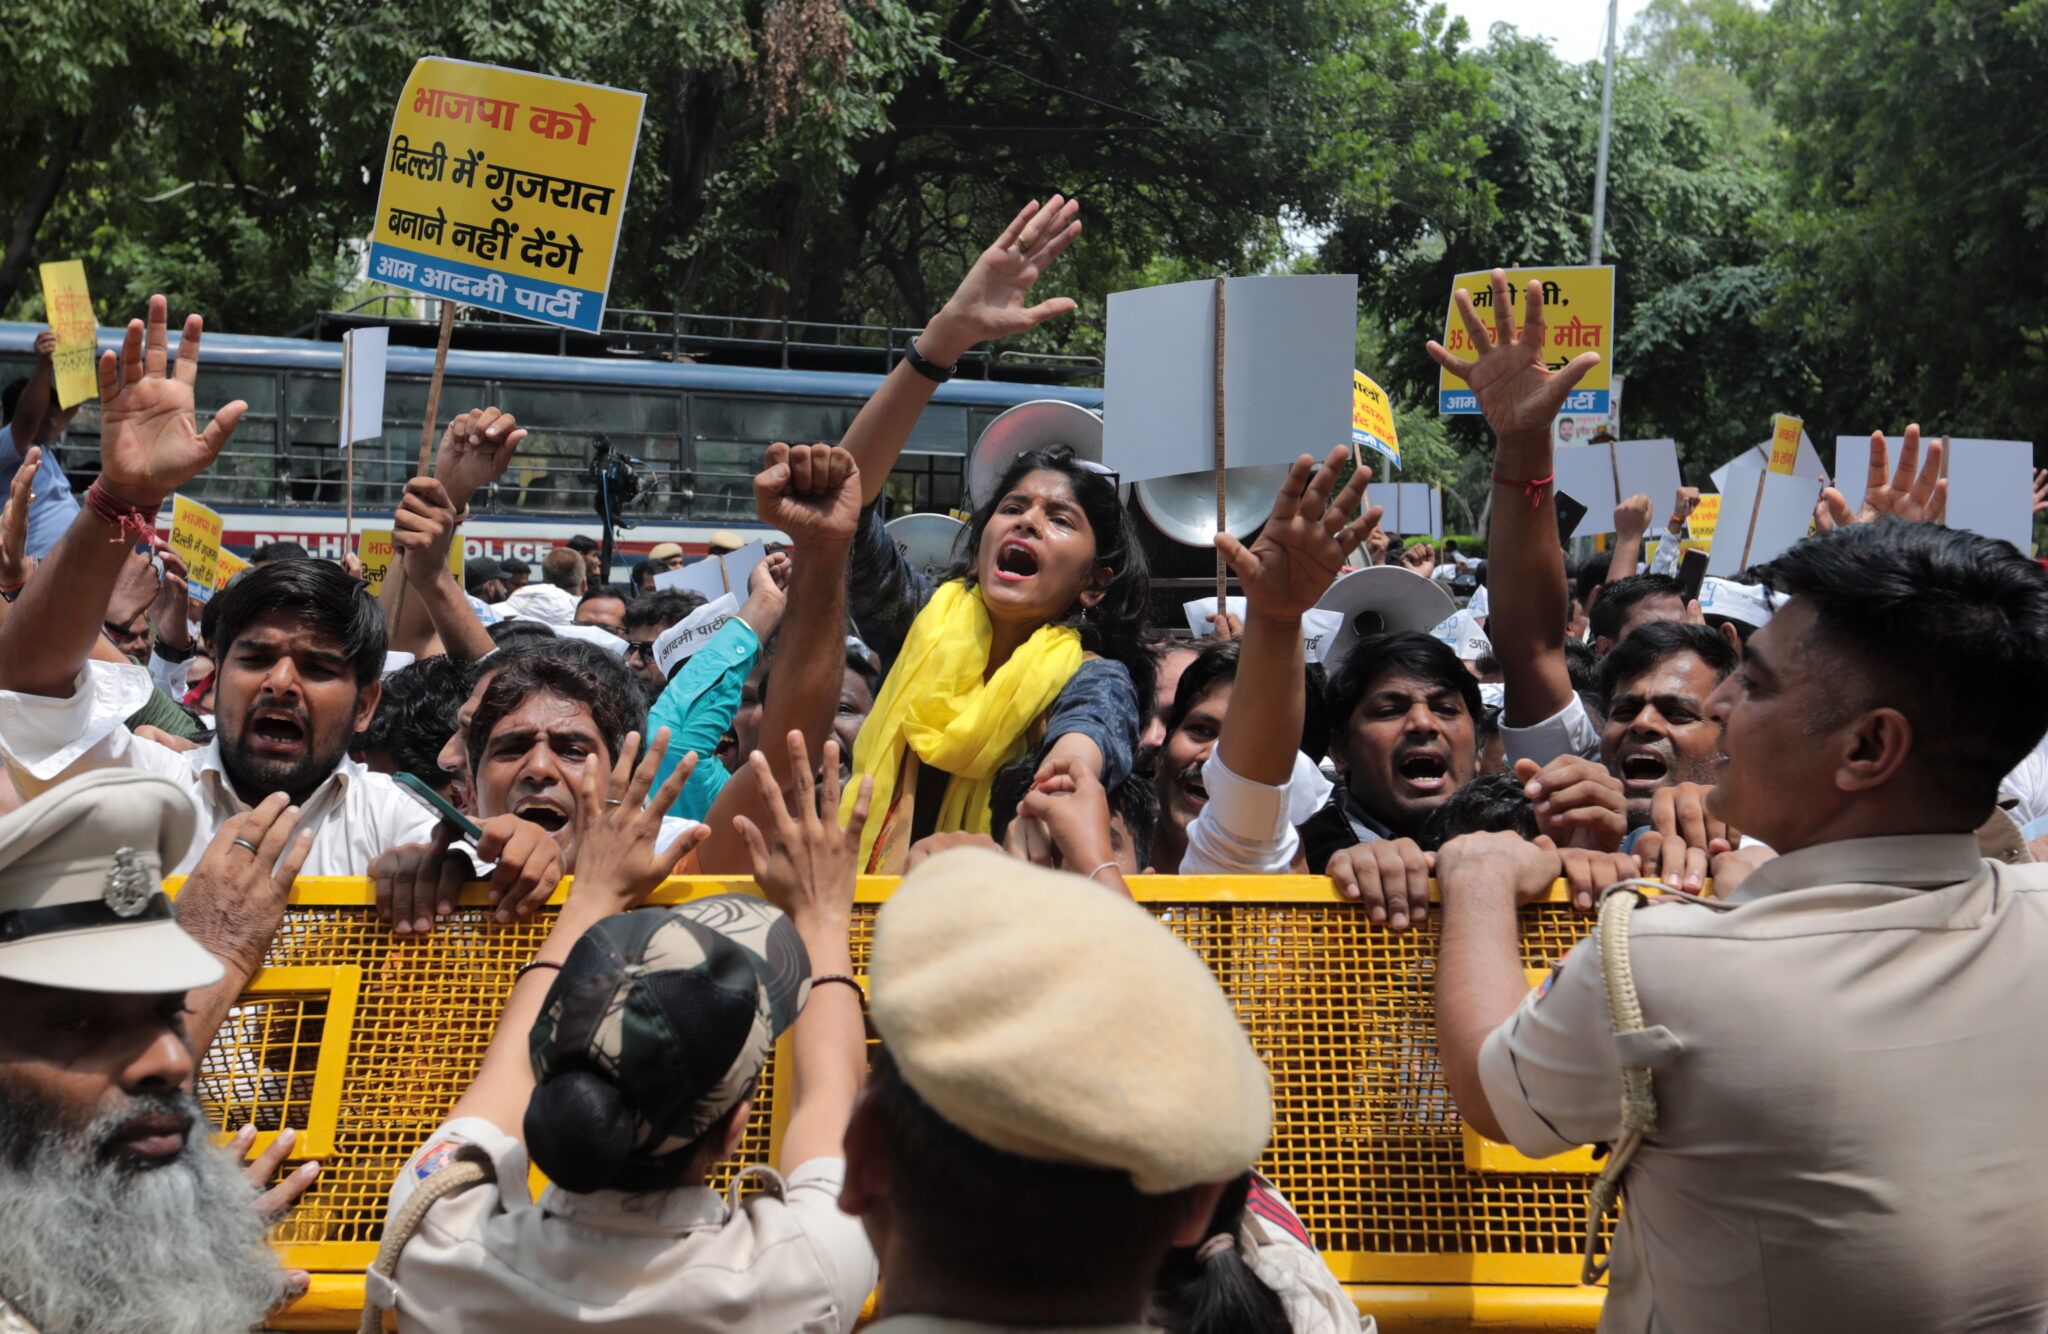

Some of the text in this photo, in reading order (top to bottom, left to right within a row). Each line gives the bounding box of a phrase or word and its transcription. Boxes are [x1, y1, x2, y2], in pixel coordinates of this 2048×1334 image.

[413, 87, 596, 146] भाजपा को
[390, 134, 615, 216] दिल्ली में गुजरात
[388, 206, 583, 275] बनाने नहीं देंगे
[376, 255, 583, 320] आम आदमी पार्टी
[1449, 329, 1463, 350] 35
[1554, 315, 1603, 348] मौत
[464, 539, 554, 564] OLICE
